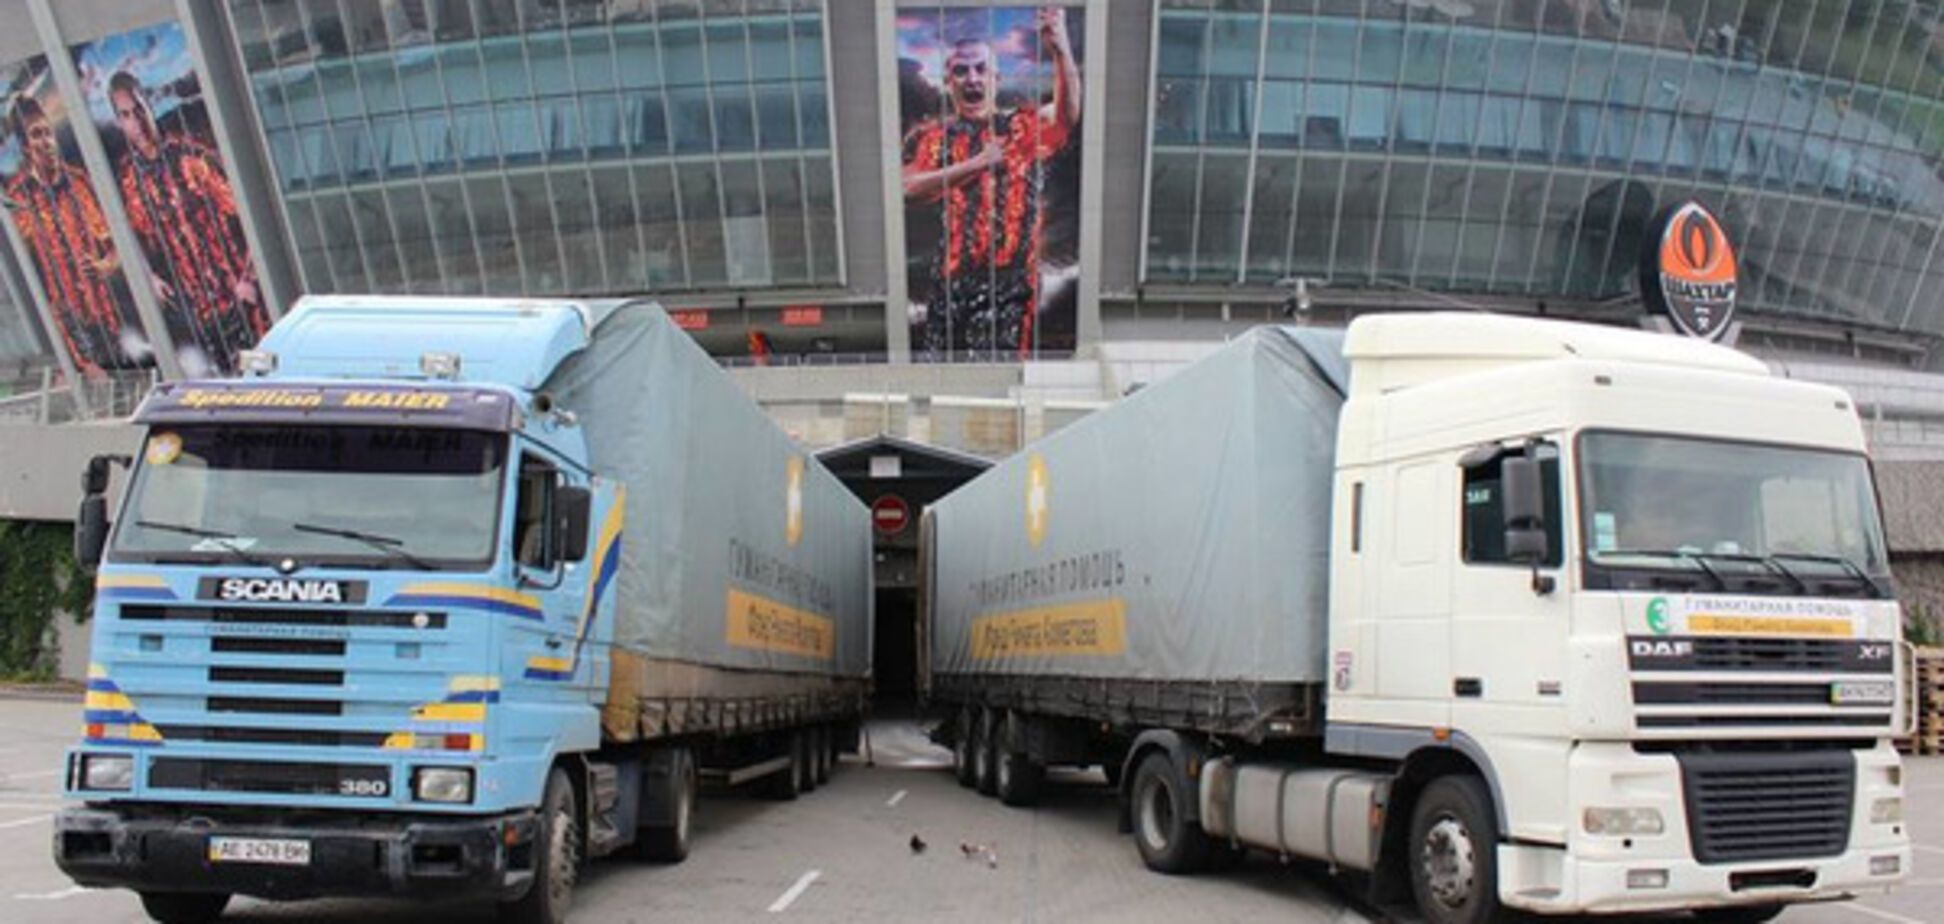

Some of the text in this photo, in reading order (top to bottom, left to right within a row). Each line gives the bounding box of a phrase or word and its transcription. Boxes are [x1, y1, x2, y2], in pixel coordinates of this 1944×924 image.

[180, 390, 449, 409] Spedition MAIER
[221, 579, 341, 602] SCANIA
[1633, 641, 1890, 659] DAF XF
[340, 780, 387, 795] 380
